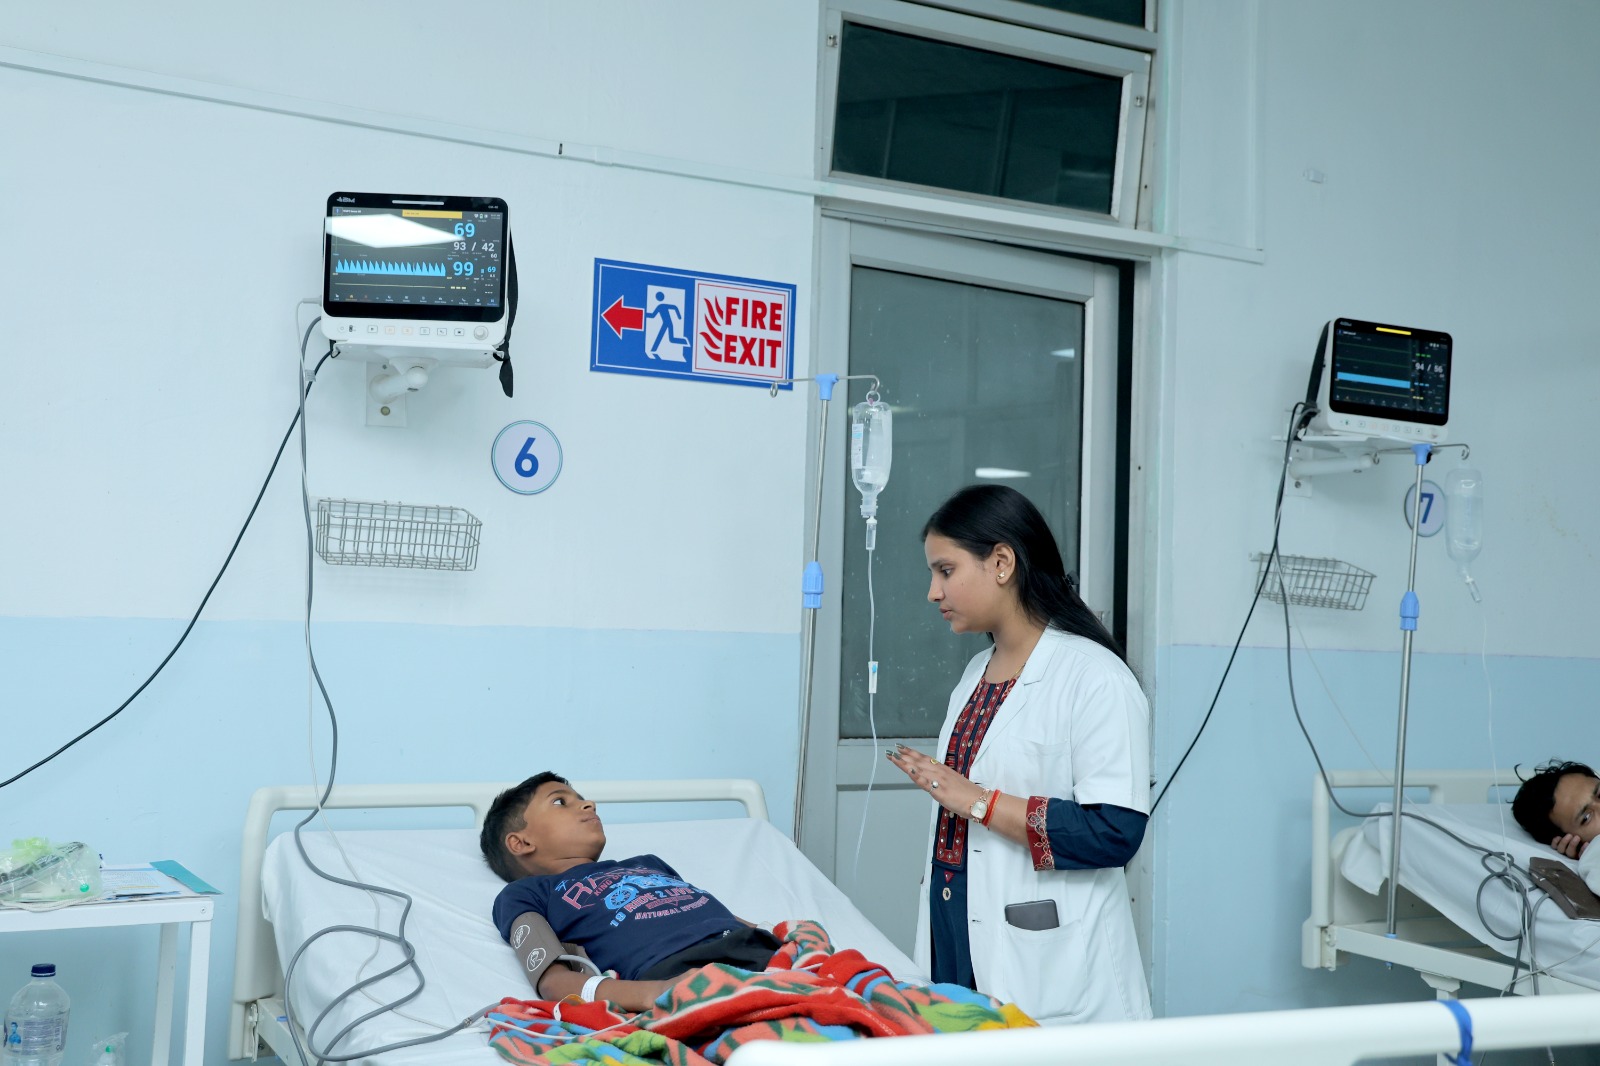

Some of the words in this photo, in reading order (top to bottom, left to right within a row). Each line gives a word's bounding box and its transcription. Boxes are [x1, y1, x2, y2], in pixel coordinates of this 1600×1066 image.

[454, 222, 475, 238] 69
[453, 242, 467, 251] 93
[471, 241, 477, 252] /
[481, 242, 495, 252] 42
[453, 261, 474, 277] 99
[725, 296, 783, 332] FIRE
[724, 334, 782, 369] EXIT
[514, 436, 539, 478] 6
[1420, 492, 1434, 524] 7
[593, 878, 613, 897] KING
[623, 892, 657, 913] RIDE
[655, 890, 667, 898] 2
[634, 907, 681, 920] NATIONAL
